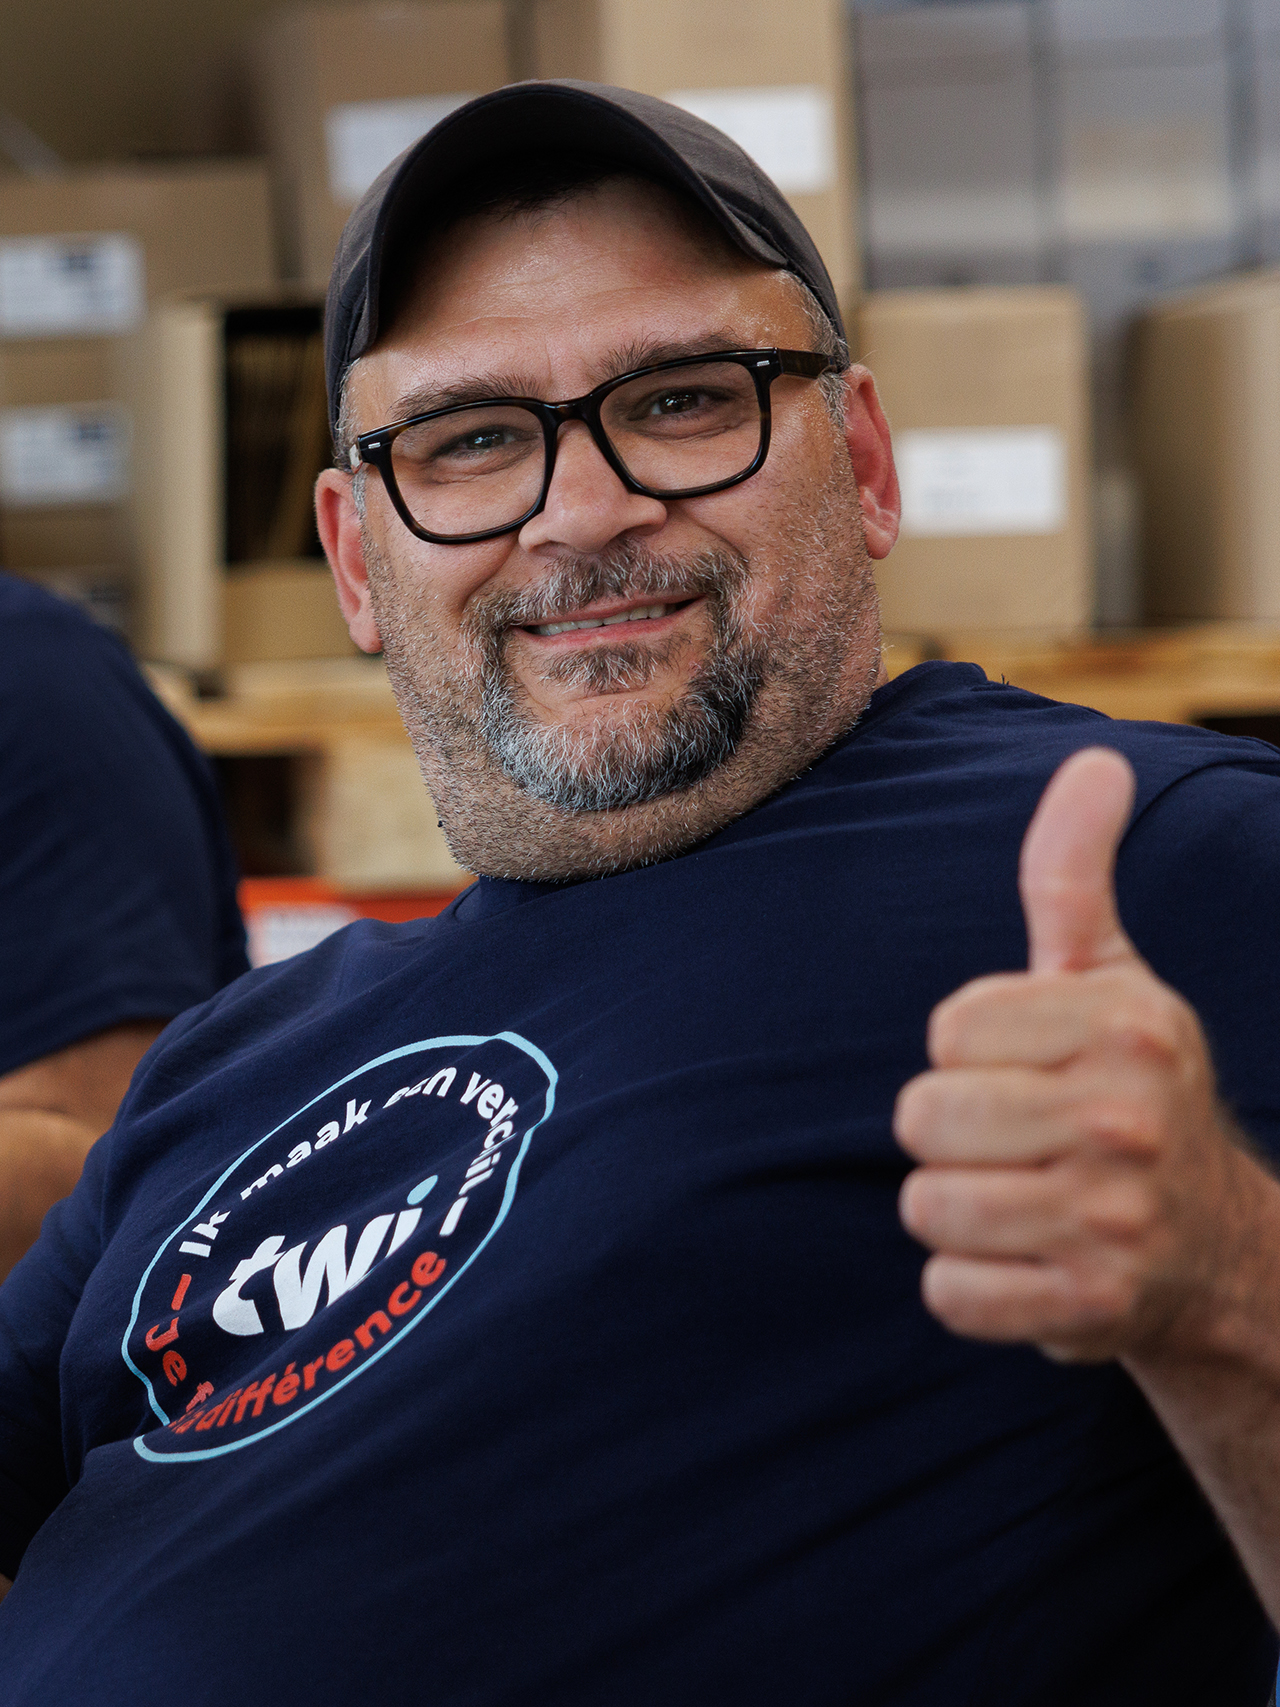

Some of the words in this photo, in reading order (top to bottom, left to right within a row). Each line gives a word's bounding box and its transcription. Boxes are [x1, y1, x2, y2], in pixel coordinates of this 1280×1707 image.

[178, 1210, 231, 1257] Ik
[240, 1099, 371, 1201] maak
[459, 1072, 519, 1195] vercil
[195, 1251, 446, 1431] différence
[212, 1174, 439, 1336] twi
